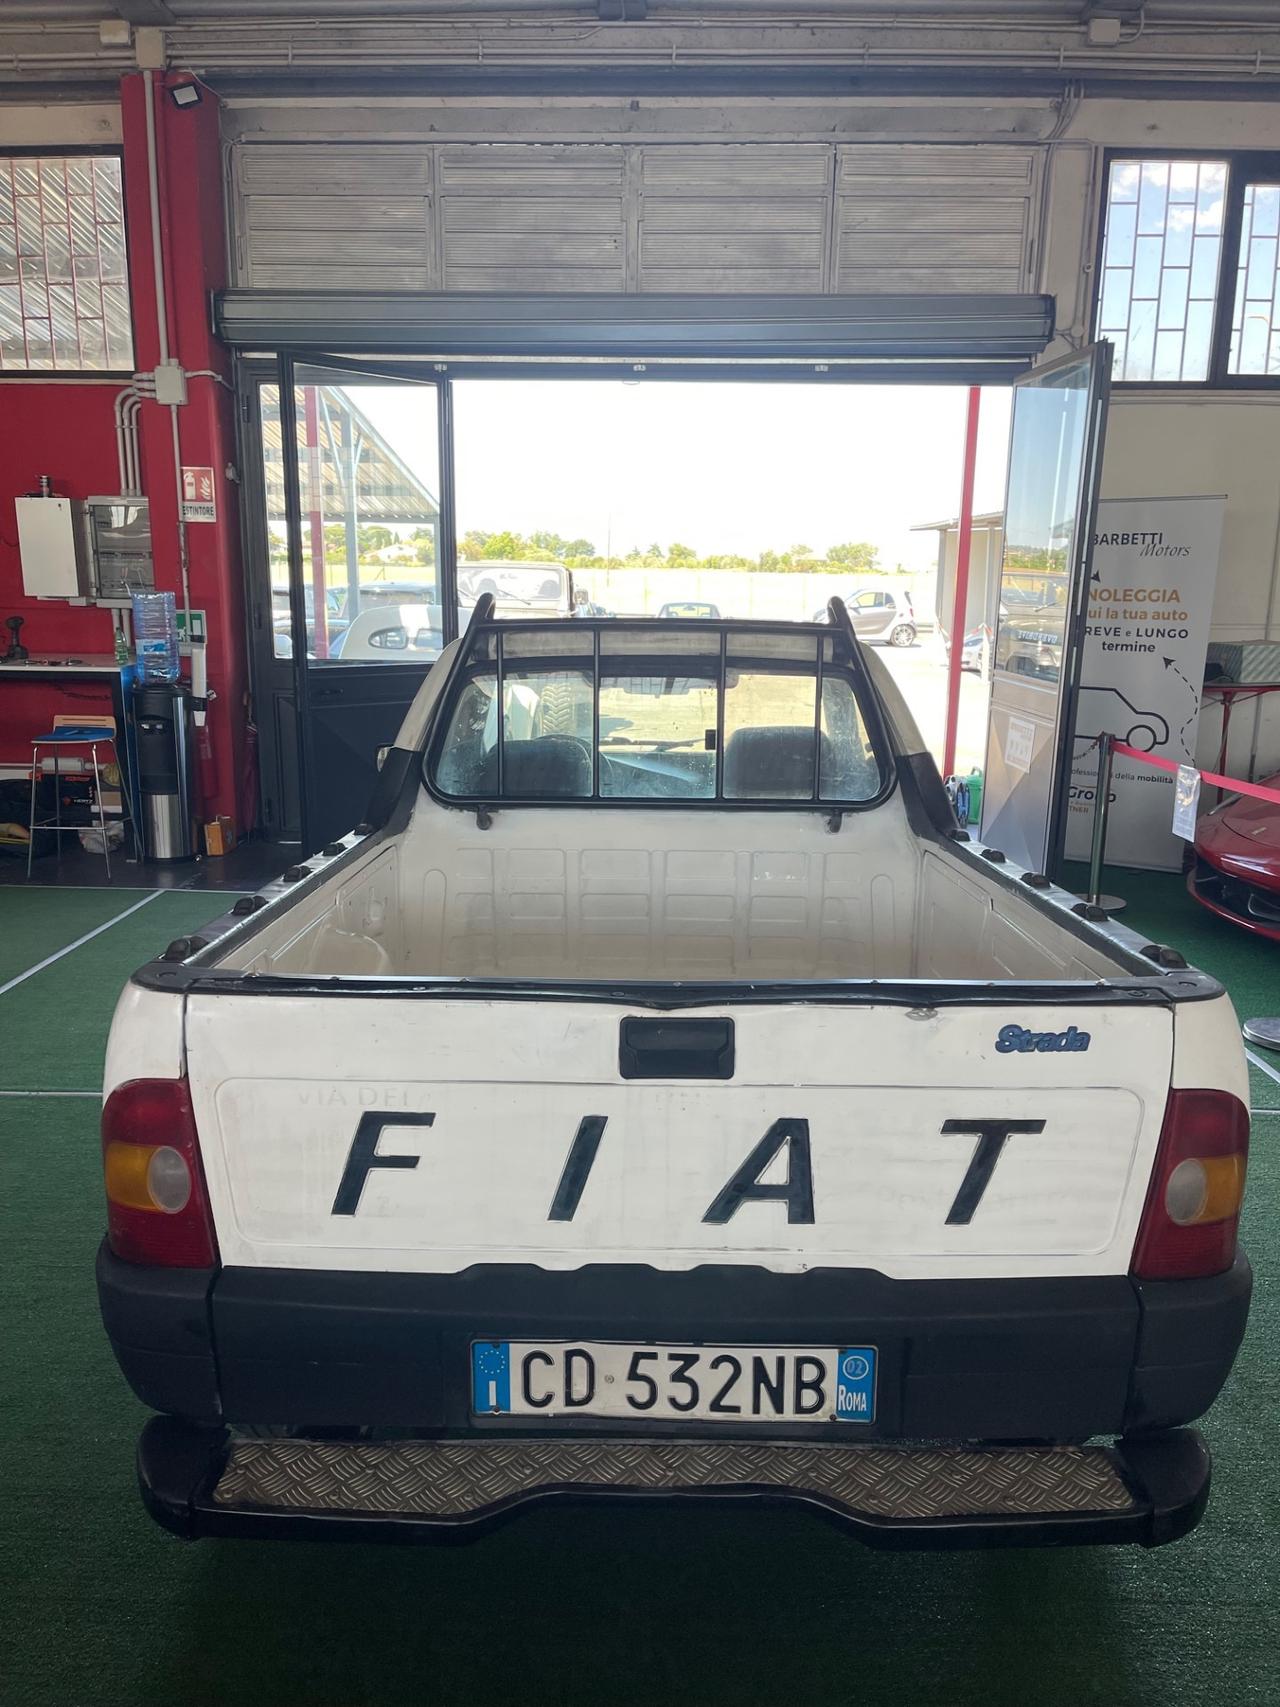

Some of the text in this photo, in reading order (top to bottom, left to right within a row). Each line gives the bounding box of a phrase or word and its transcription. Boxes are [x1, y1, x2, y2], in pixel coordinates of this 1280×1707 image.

[182, 505, 214, 516] ESTINTORE
[1139, 543, 1192, 557] Motors
[1089, 588, 1181, 603] NOLEGGIA
[1106, 607, 1118, 620] la
[1123, 608, 1148, 620] tua
[1151, 609, 1189, 621] auto
[1136, 628, 1189, 639] LUNGO
[1102, 641, 1156, 653] termine
[1137, 774, 1174, 784] mobilità
[995, 1024, 1091, 1053] Strada
[331, 1111, 1047, 1225] FIAT
[521, 1348, 595, 1408] CD
[625, 1350, 828, 1415] 532NB
[846, 1360, 863, 1374] 02
